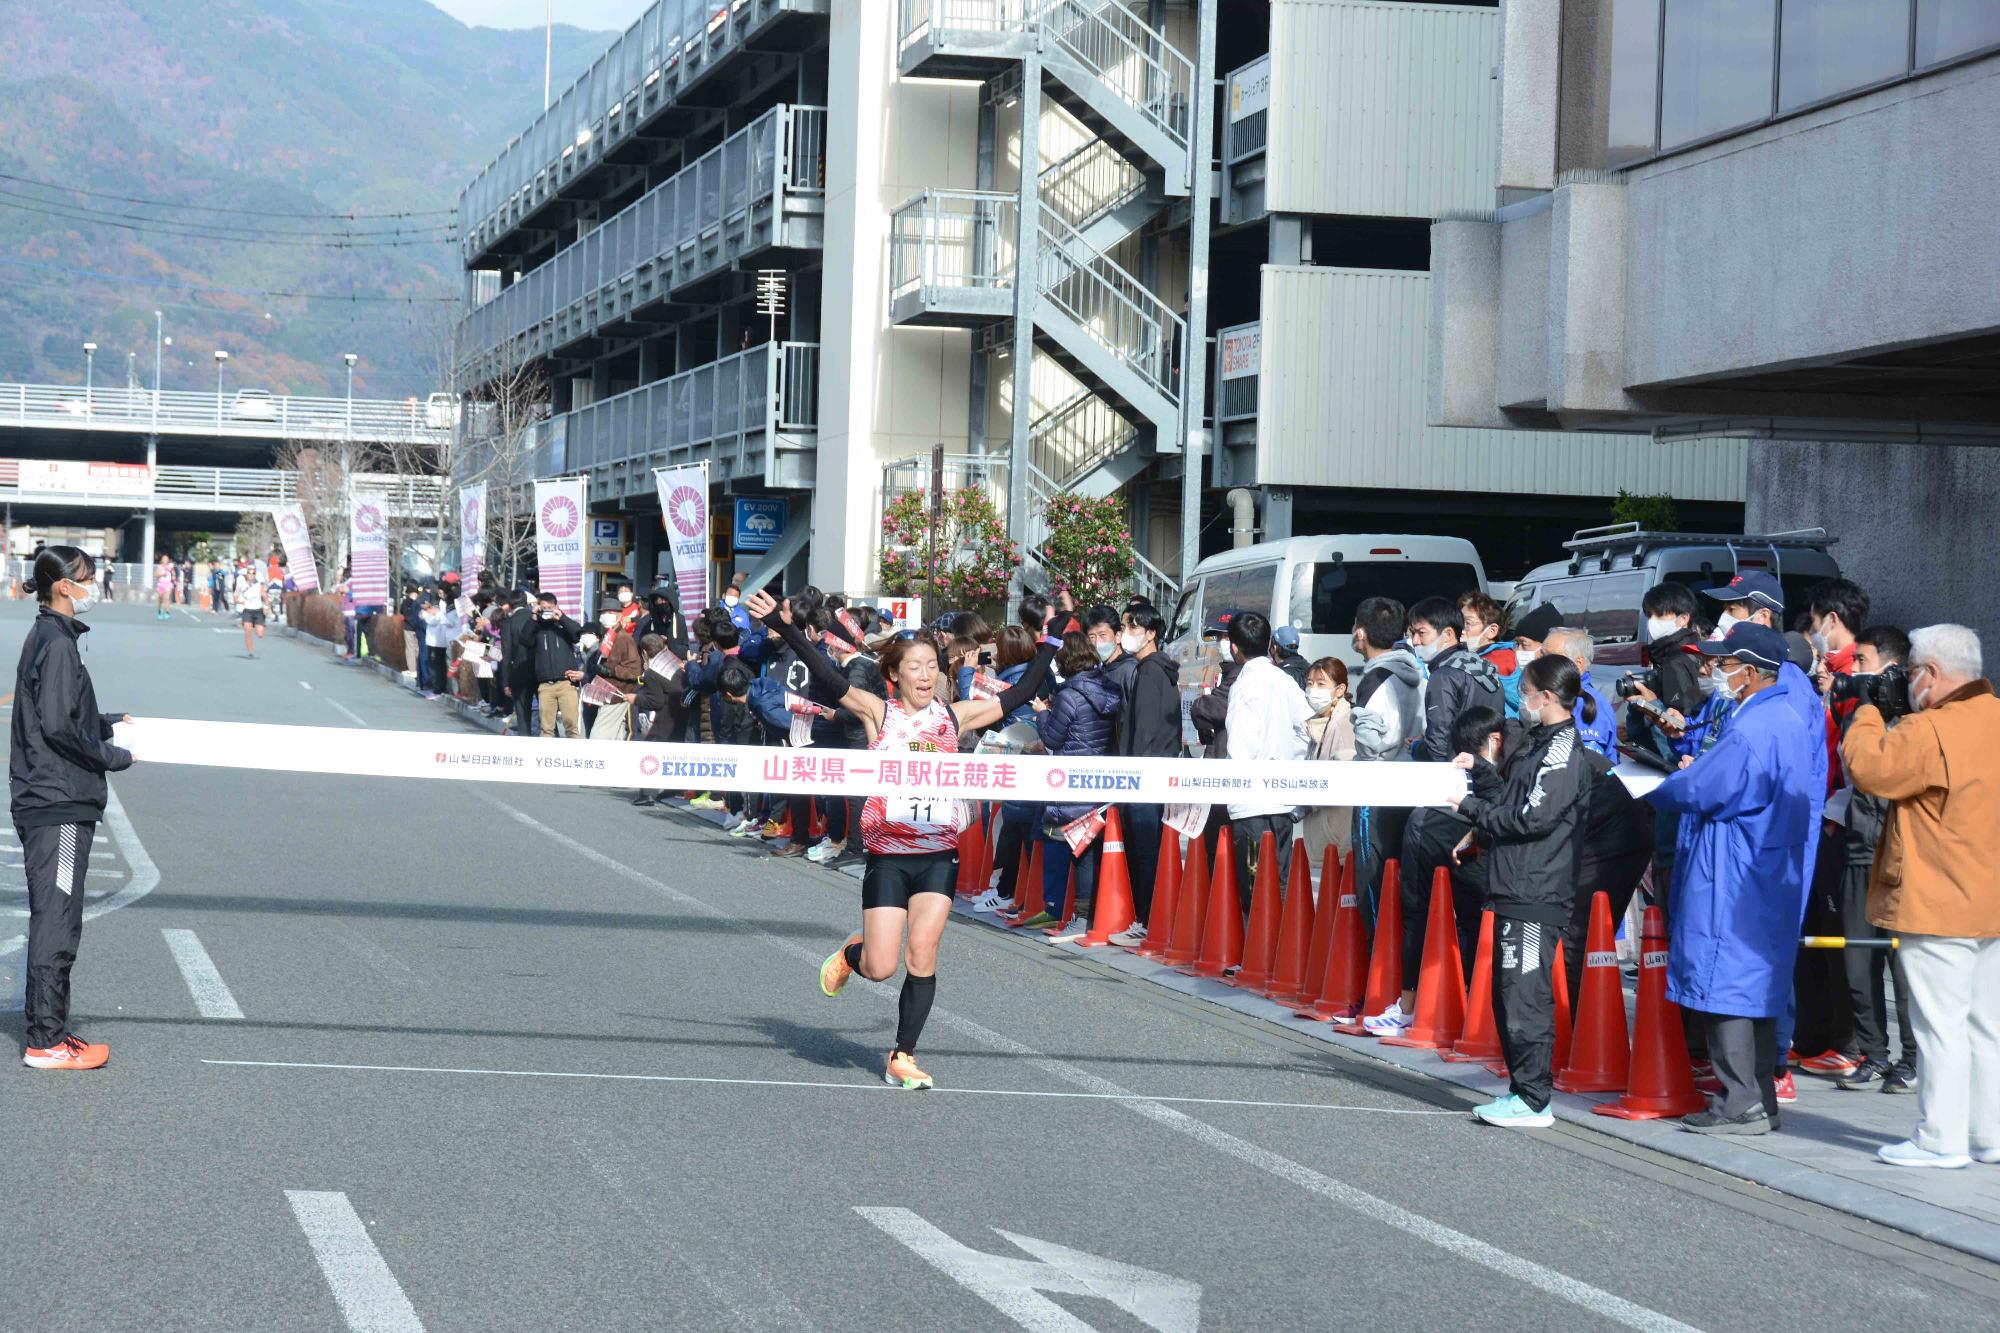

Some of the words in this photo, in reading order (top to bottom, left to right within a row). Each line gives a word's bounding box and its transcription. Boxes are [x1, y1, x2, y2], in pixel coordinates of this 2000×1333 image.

[1252, 333, 1260, 349] 2F
[744, 503, 755, 511] EV
[449, 754, 524, 767] 山梨日日新聞社
[535, 757, 606, 770] YBS山梨放送
[661, 761, 737, 778] EKIDEN
[763, 754, 1017, 789] 山梨県一周駅伝競走
[1068, 774, 1141, 790] EKIDEN
[1181, 777, 1252, 788] 山梨日日新聞社
[1262, 778, 1329, 790] YBS山梨放送
[909, 803, 932, 822] 11
